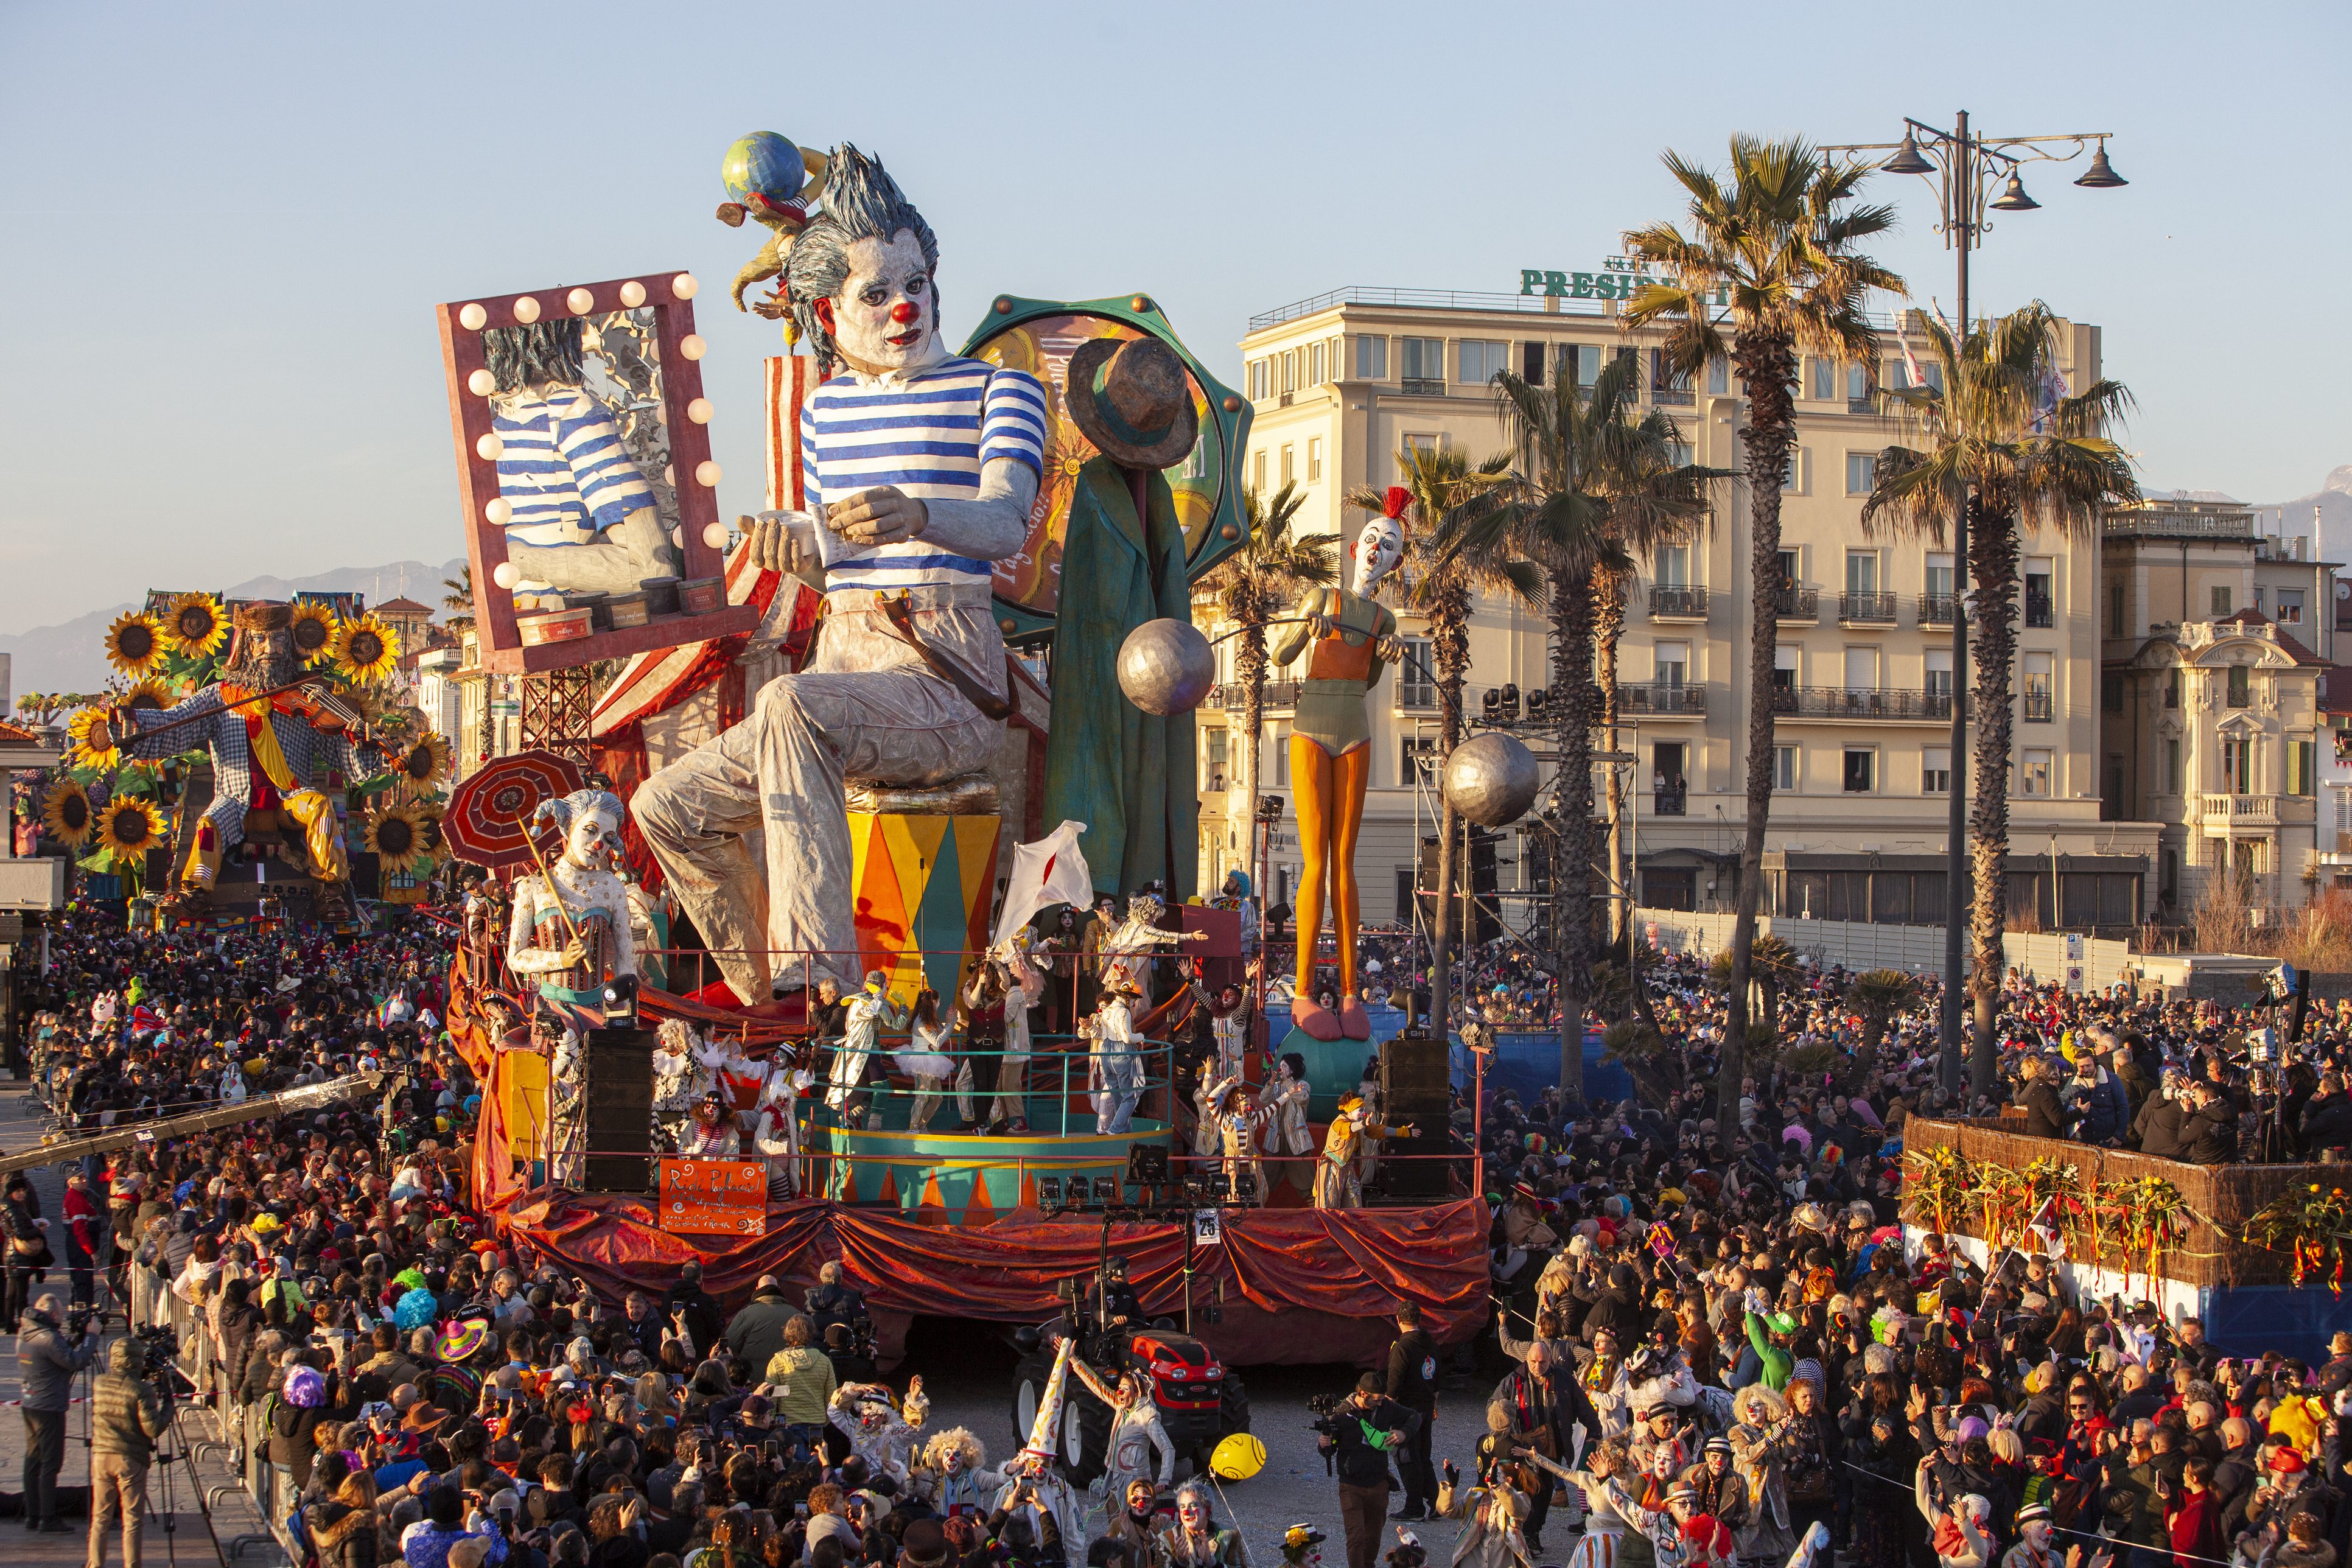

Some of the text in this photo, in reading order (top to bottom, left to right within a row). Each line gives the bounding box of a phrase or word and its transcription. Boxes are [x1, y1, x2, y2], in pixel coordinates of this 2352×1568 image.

[1521, 270, 1732, 306] PRESIT
[503, 684, 510, 692] 9
[136, 1130, 155, 1141] Rai
[668, 1168, 704, 1192] Ridi
[1199, 1217, 1216, 1236] 25
[461, 1307, 481, 1315] BOUNTY
